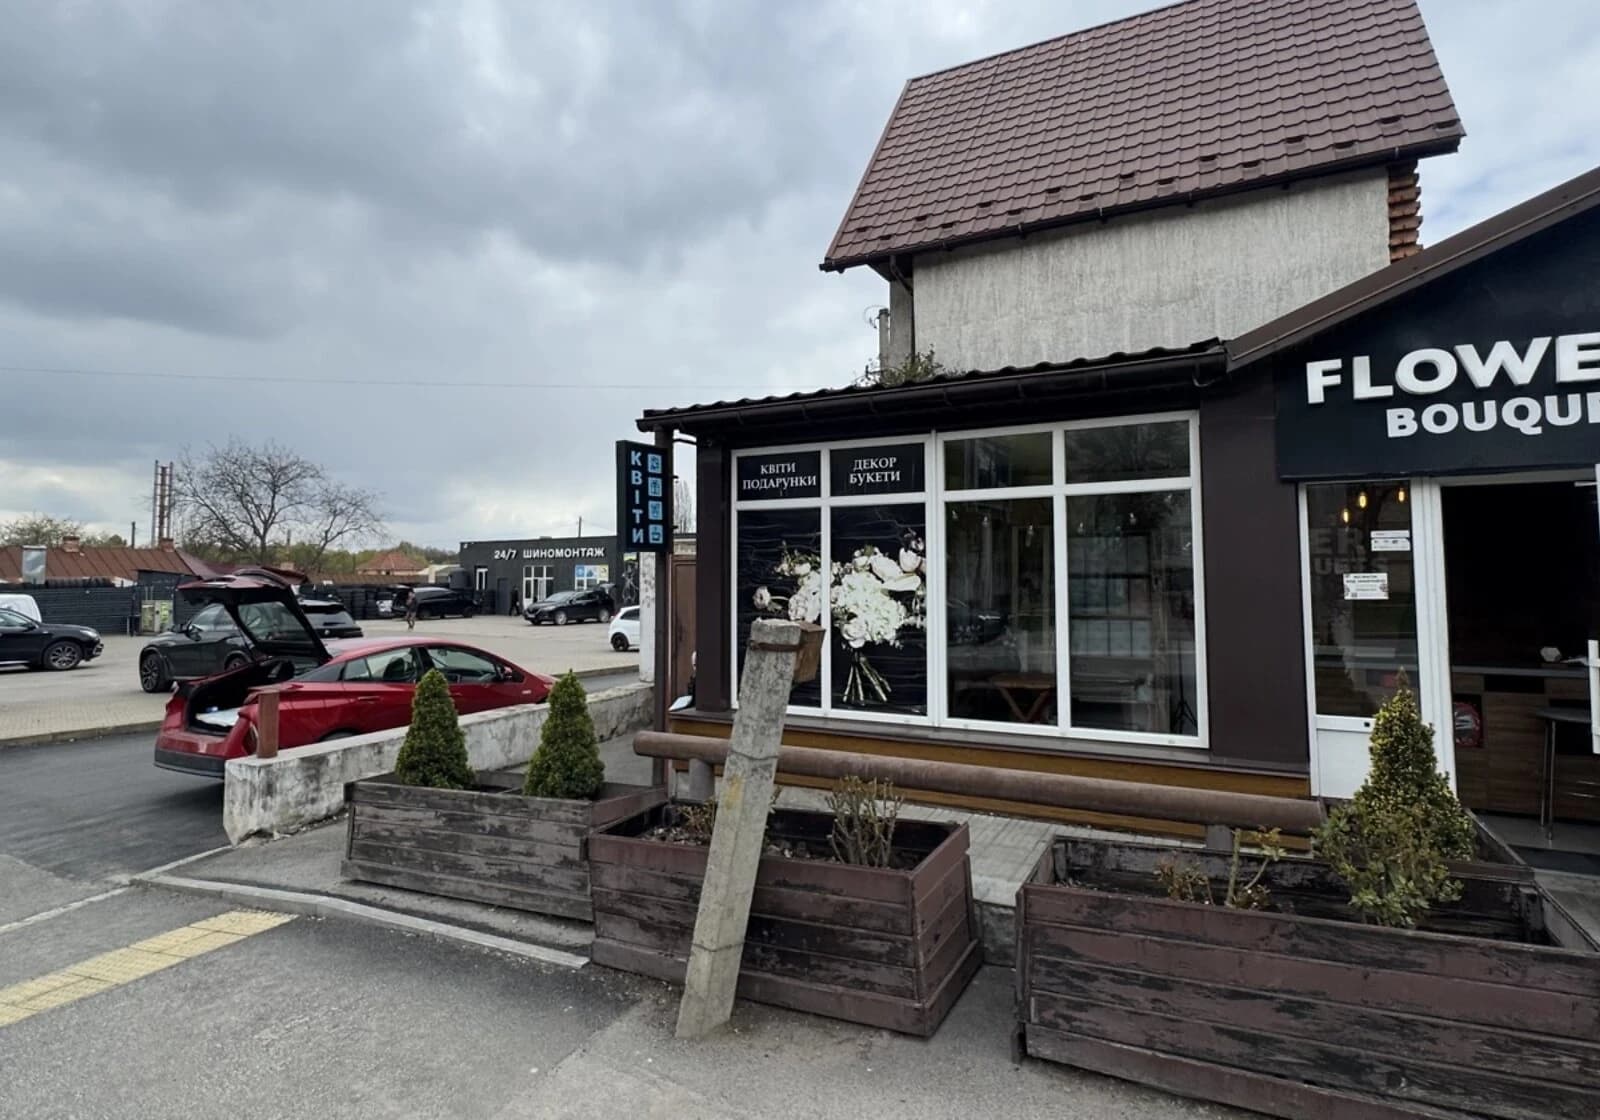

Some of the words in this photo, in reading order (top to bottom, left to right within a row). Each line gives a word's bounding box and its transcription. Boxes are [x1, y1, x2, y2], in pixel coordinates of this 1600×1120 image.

[1306, 331, 1600, 404] FLOWE
[760, 462, 797, 475] КВІТИ
[853, 456, 897, 472] ДЕКОР
[742, 475, 817, 490] ПОДАРУНКИ
[849, 470, 901, 487] БУКЕТИ
[630, 450, 644, 544] КВІТИ
[494, 549, 517, 560] 24/7
[522, 547, 605, 559] ШИНОМОНТАЖ
